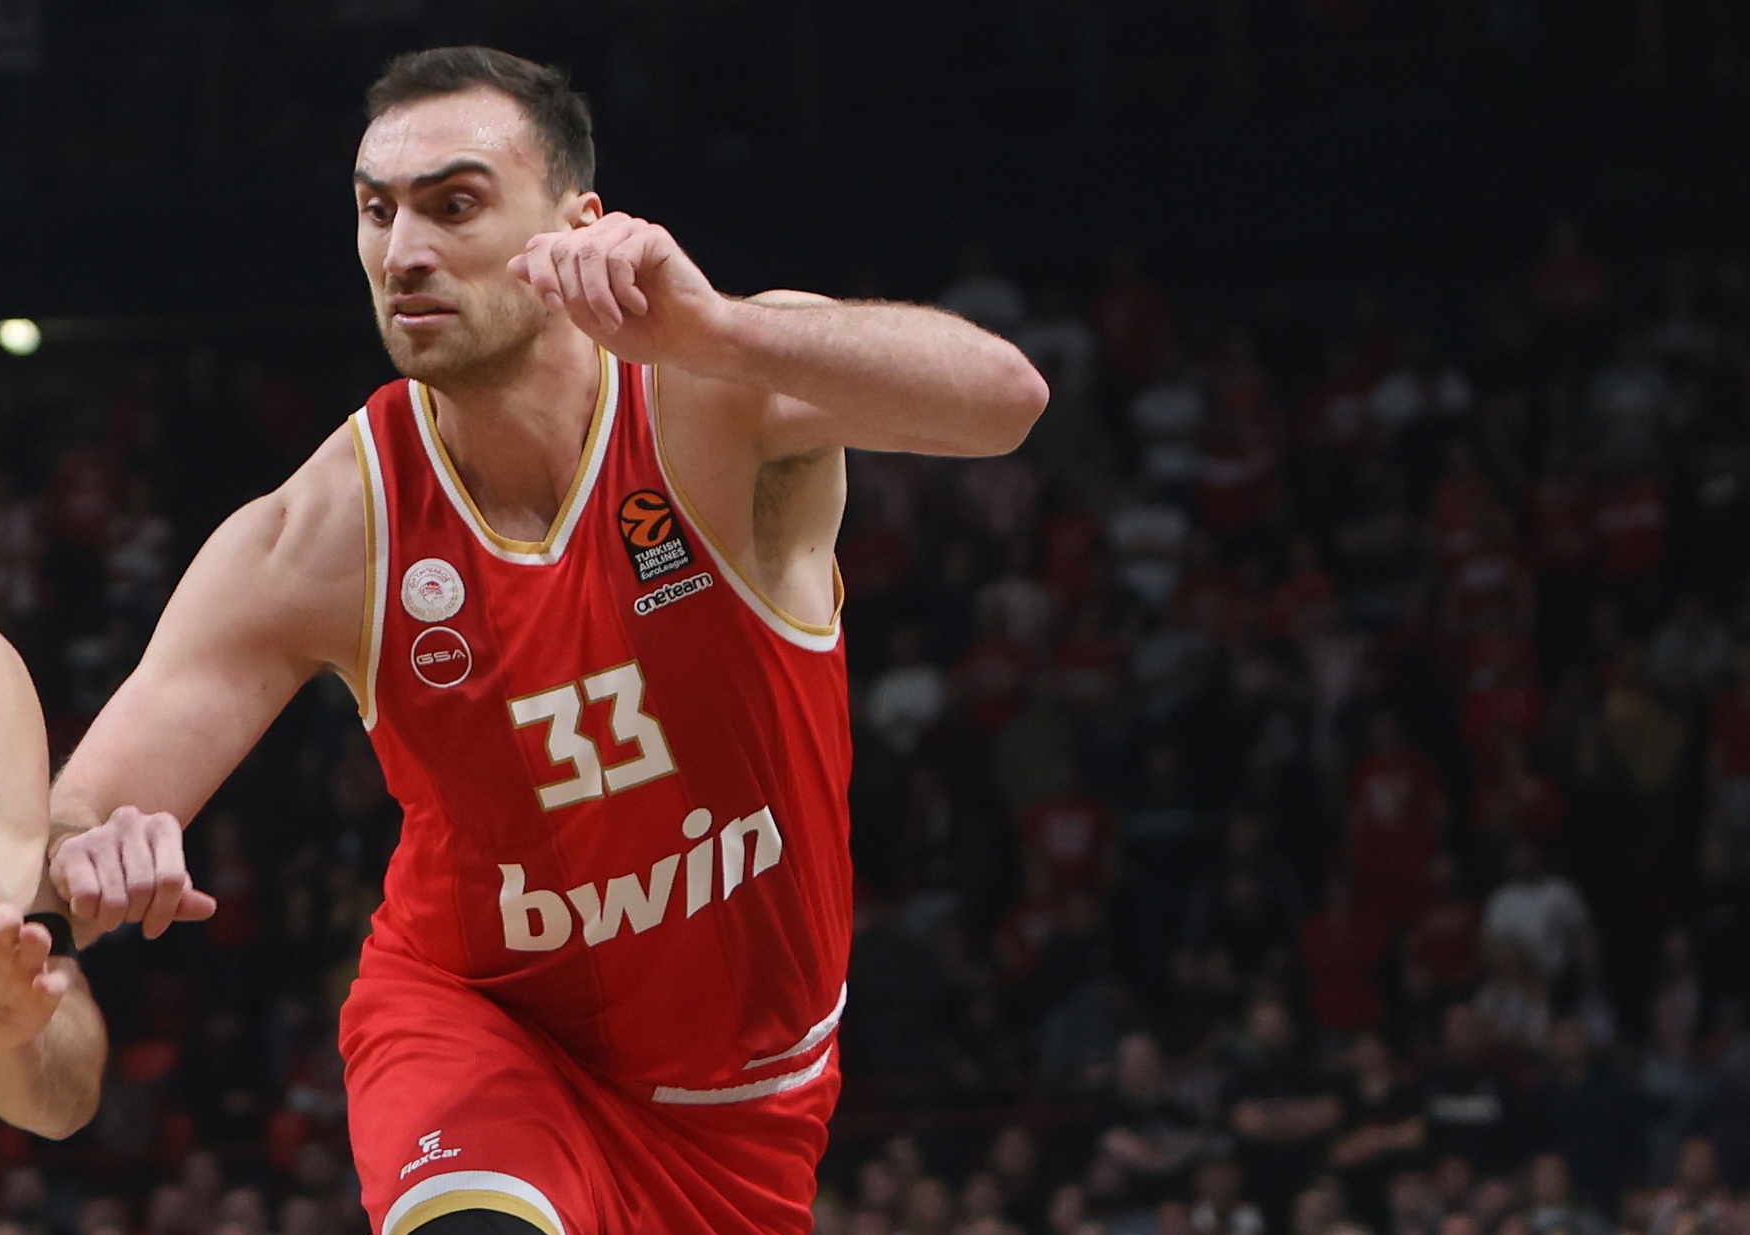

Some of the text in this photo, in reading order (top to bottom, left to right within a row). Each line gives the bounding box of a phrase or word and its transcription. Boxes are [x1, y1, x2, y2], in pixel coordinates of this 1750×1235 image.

[635, 538, 683, 562] TURKISH
[639, 547, 686, 572] AIRLINES
[641, 557, 689, 580] EuroLeague
[636, 574, 712, 613] oneteam
[416, 649, 466, 665] GSA
[507, 658, 680, 812] 33
[498, 806, 783, 951] bwin
[400, 1148, 462, 1180] FlexCar
